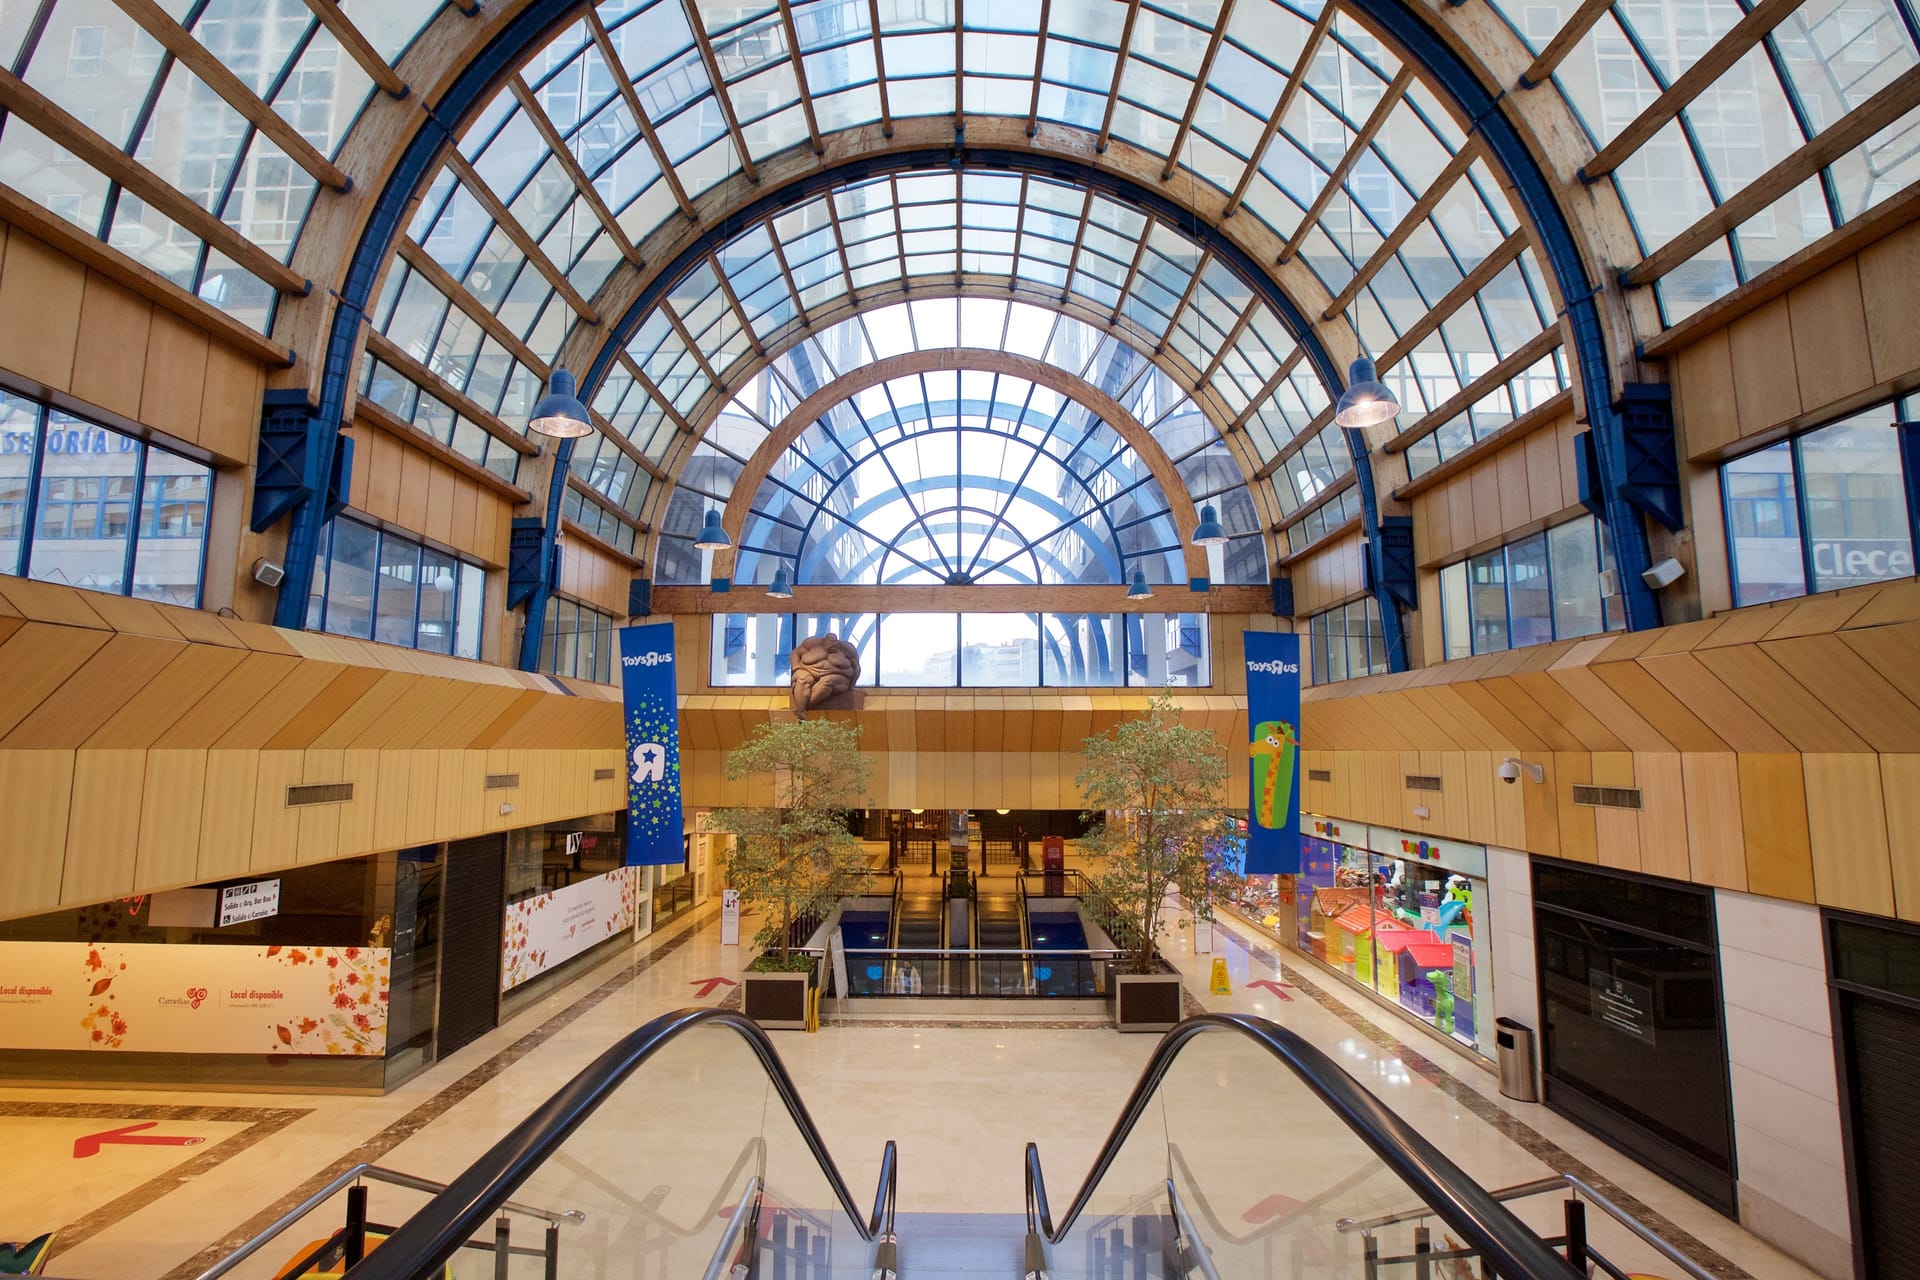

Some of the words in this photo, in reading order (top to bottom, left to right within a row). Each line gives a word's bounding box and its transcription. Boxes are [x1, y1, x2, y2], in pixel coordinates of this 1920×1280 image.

[0, 426, 107, 455] SEORÍA
[1813, 543, 1911, 575] Clece
[0, 986, 17, 995] Local
[19, 986, 52, 997] disponible
[230, 990, 248, 999] Local
[249, 990, 284, 1001] disponible
